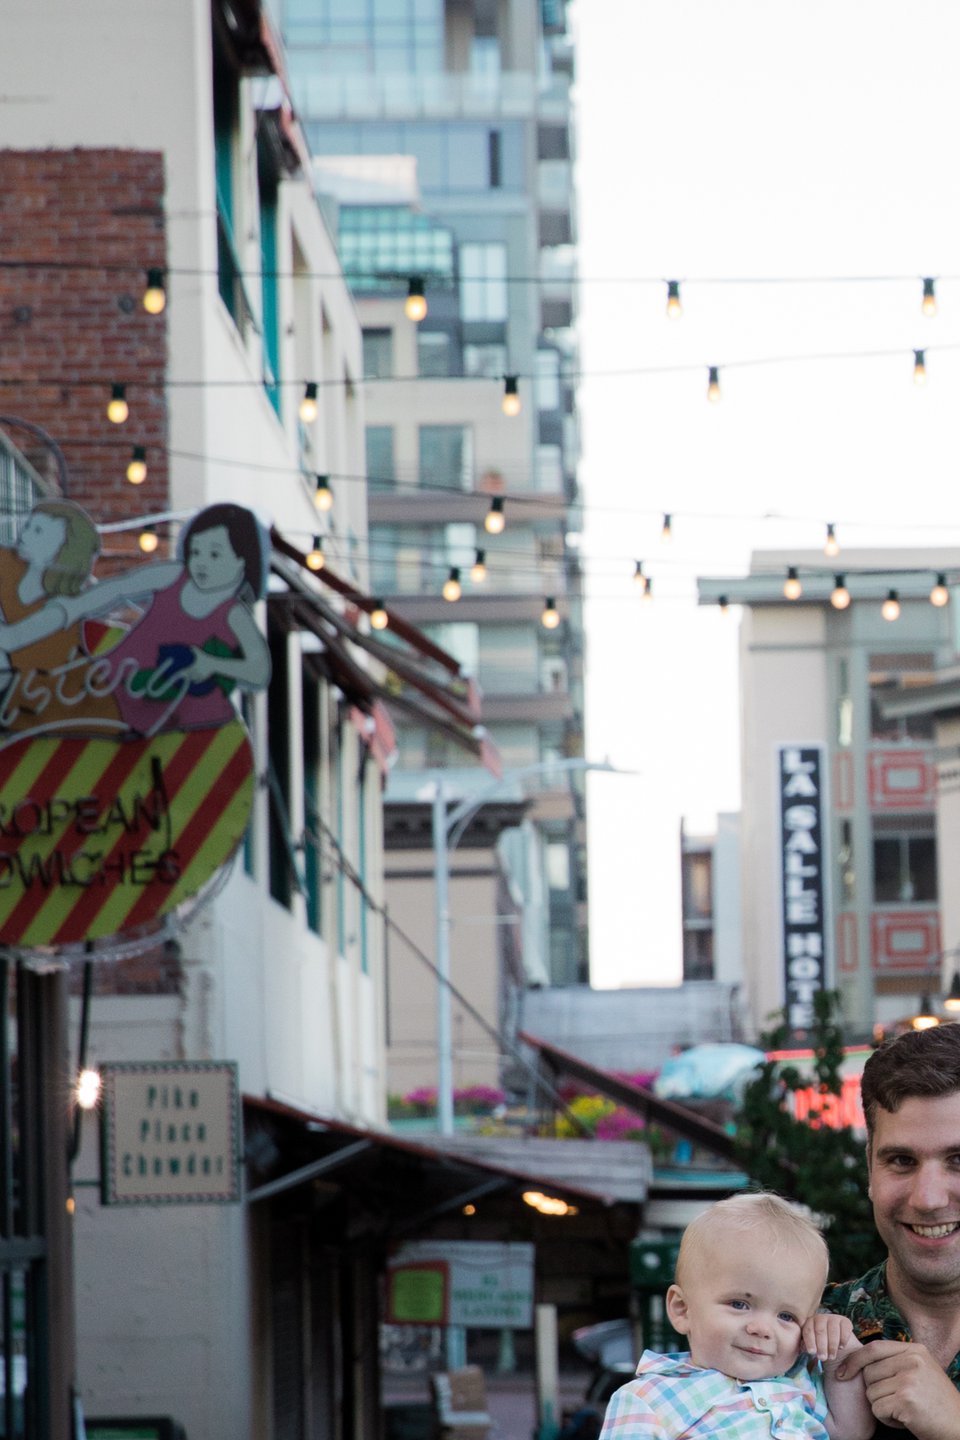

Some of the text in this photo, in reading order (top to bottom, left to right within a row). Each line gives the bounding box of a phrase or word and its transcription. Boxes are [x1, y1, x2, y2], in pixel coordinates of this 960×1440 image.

[783, 750, 822, 1030] LA SALLE HOTE
[147, 1085, 199, 1110] Pike
[140, 1118, 207, 1142] Place
[122, 1152, 223, 1177] Chowder
